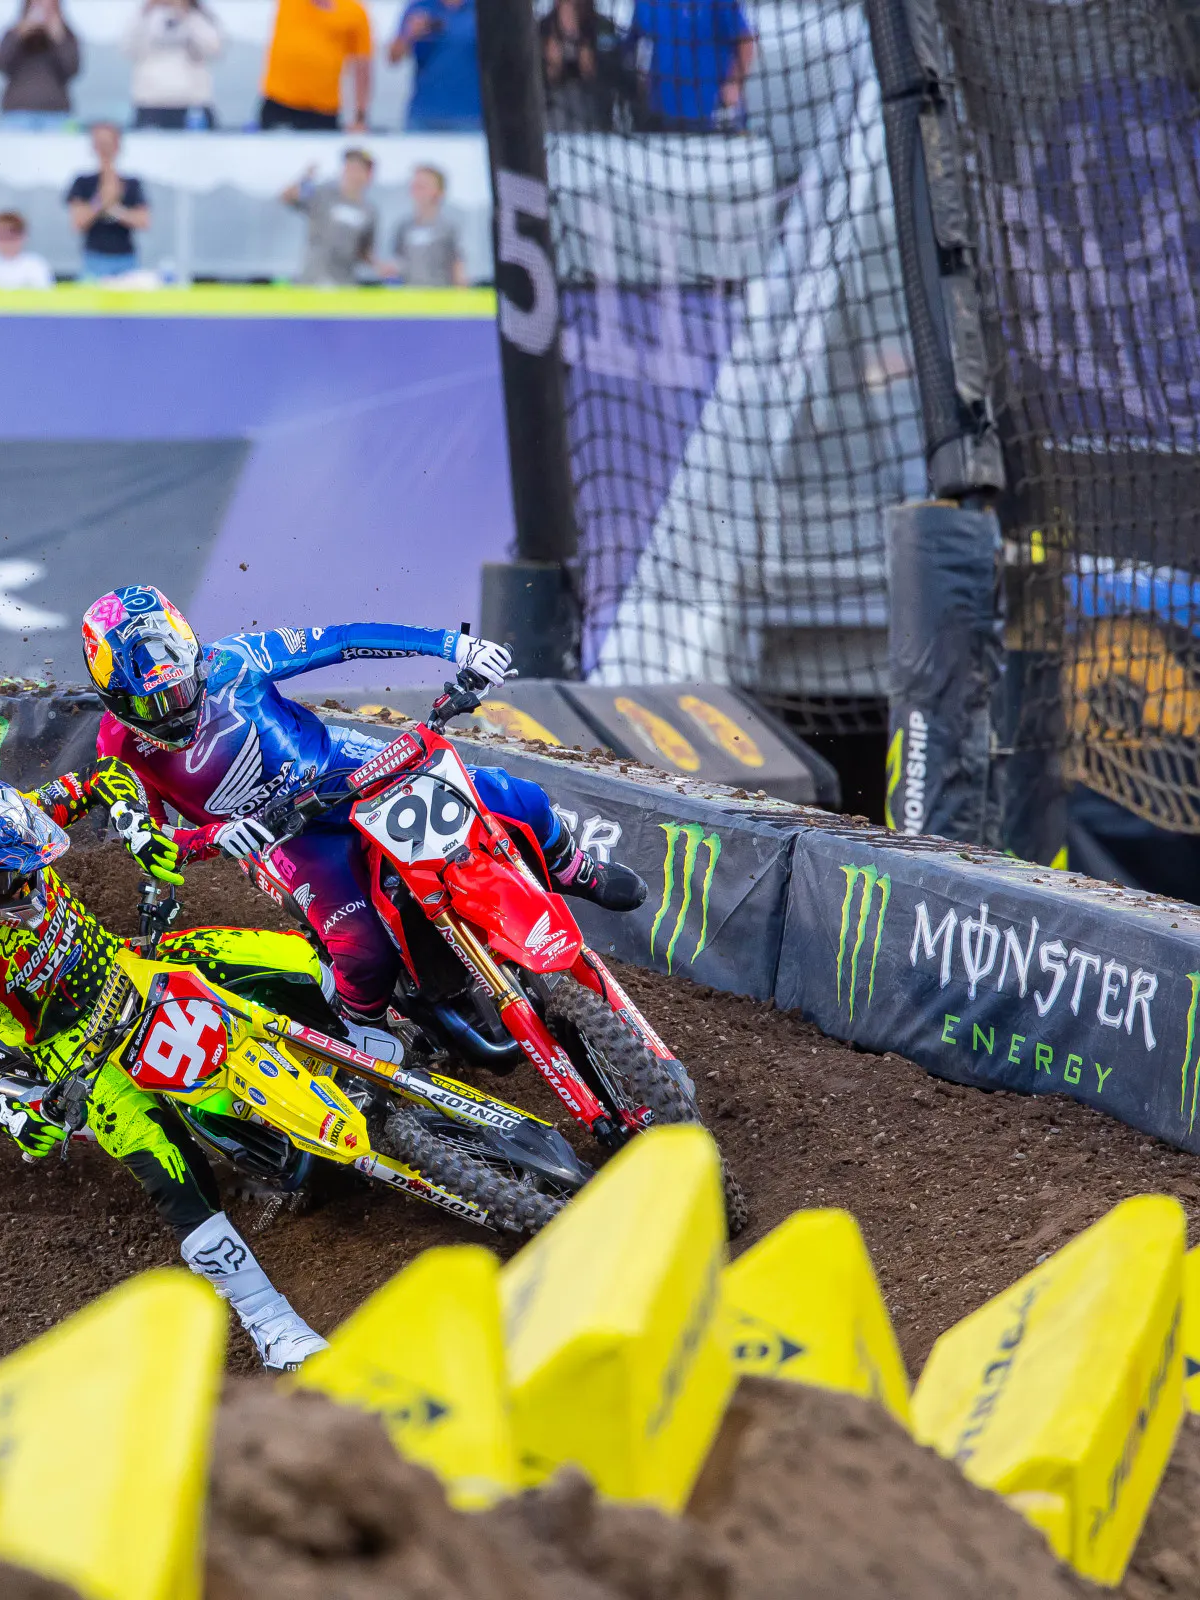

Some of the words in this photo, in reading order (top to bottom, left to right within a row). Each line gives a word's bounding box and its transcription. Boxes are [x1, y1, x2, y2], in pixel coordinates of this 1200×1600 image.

[497, 168, 558, 356] 5
[143, 677, 164, 692] Red
[163, 668, 184, 684] Bull
[341, 647, 422, 660] HONDA
[228, 758, 297, 823] HONDA
[353, 737, 410, 783] RENTHAL
[383, 774, 419, 799] SUPERCROS
[386, 768, 471, 866] 96
[5, 893, 69, 995] PROGRESSIVE
[25, 912, 79, 994] SUZUKI
[531, 929, 568, 956] HONDA
[553, 941, 578, 958] Honda
[909, 900, 1158, 1052] MONSTER
[95, 974, 132, 1049] RENTHA
[143, 992, 222, 1088] 94
[428, 1071, 486, 1103] ACERBIS
[520, 1039, 581, 1113] DUNLOP
[941, 1013, 1113, 1094] ENERGY
[430, 1092, 520, 1130] DUNLOP
